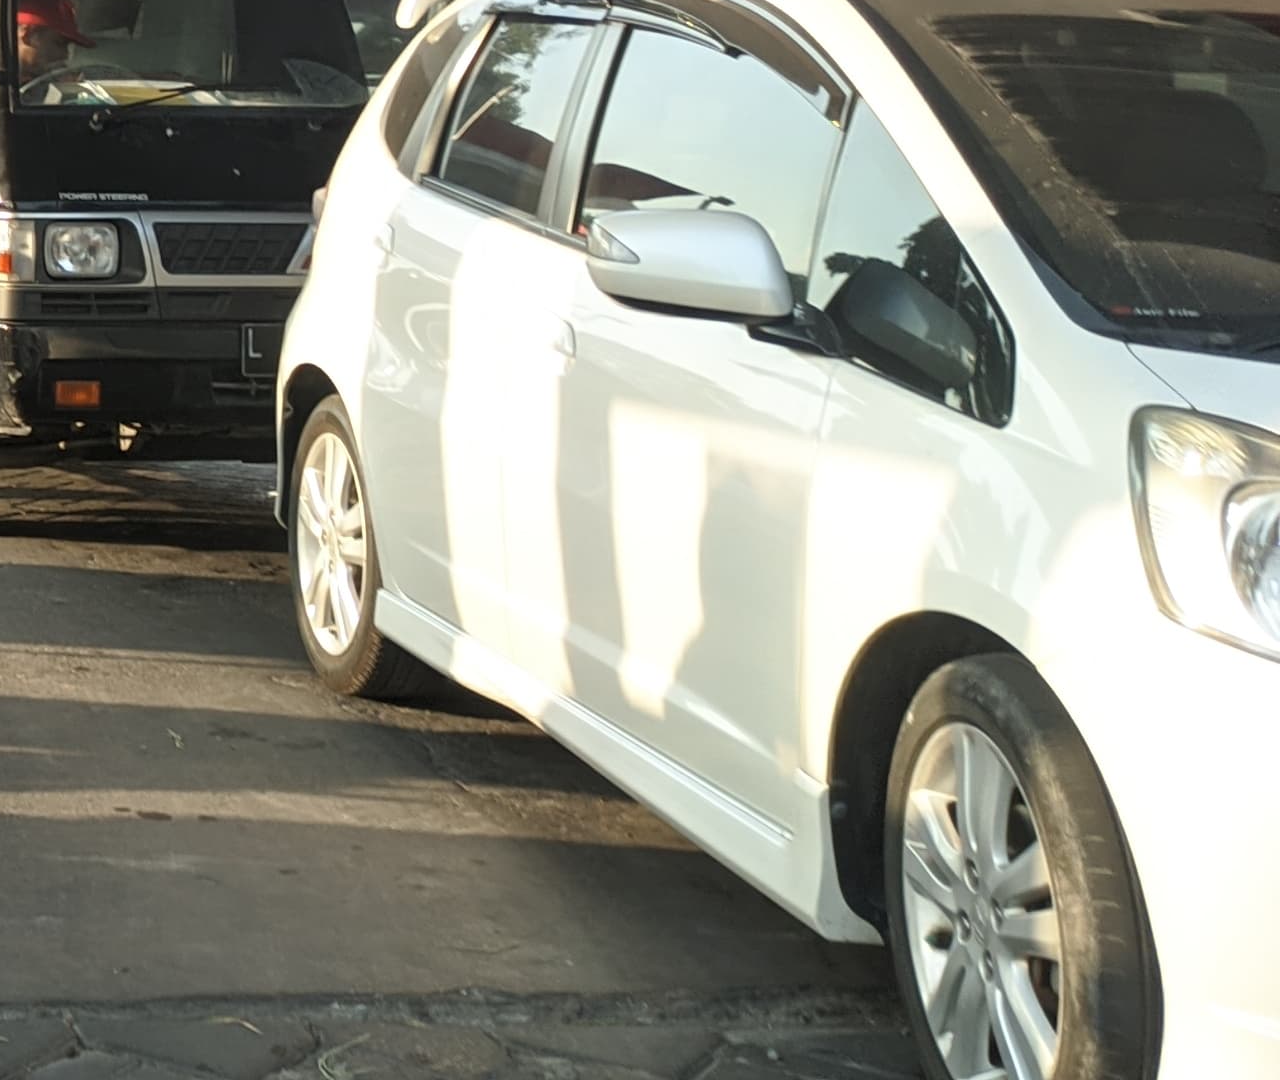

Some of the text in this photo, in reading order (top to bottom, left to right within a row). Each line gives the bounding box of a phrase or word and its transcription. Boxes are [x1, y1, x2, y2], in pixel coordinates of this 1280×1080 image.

[58, 191, 150, 201] POWER STEERING
[247, 327, 263, 358] L
